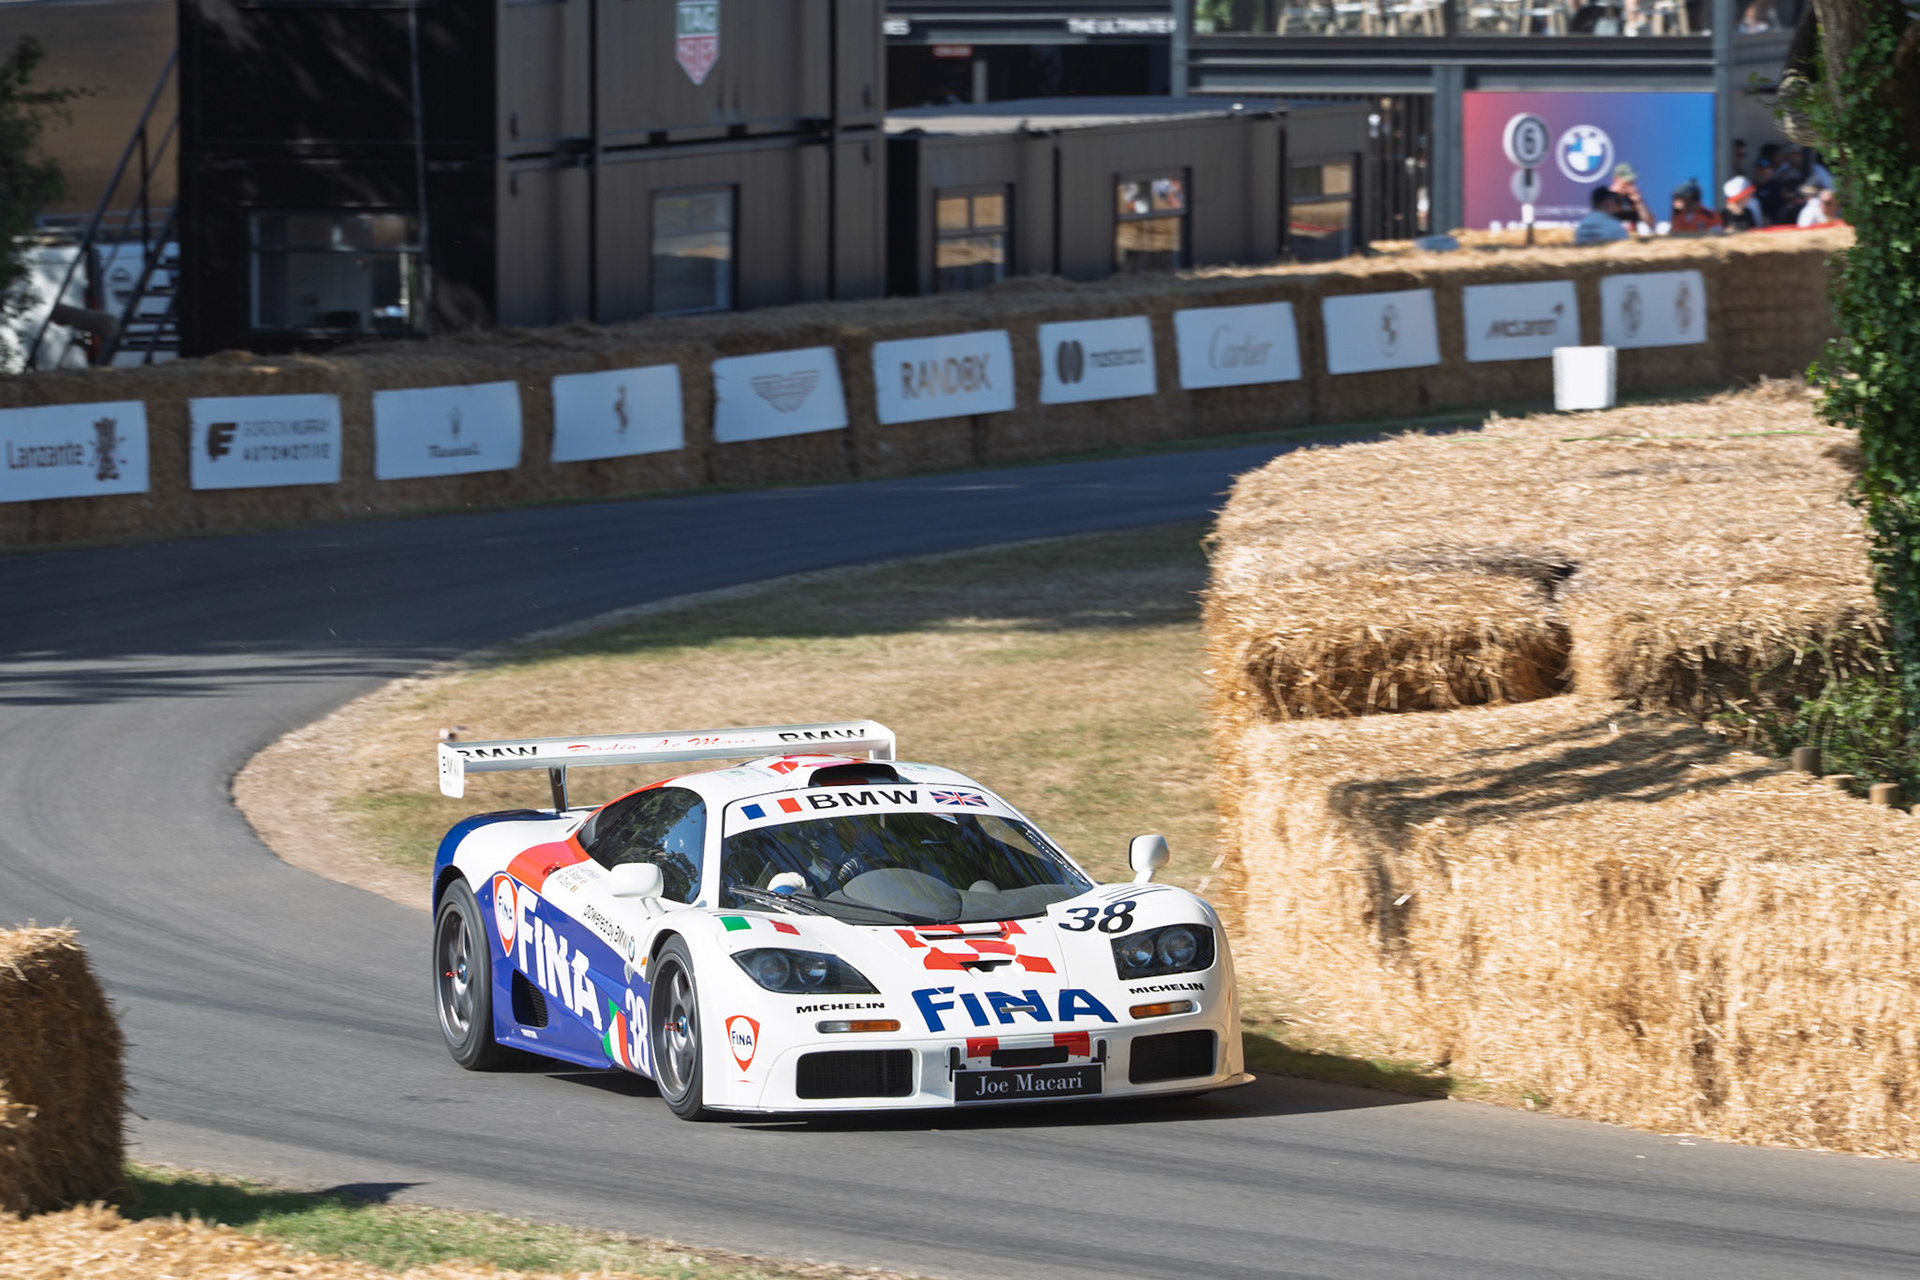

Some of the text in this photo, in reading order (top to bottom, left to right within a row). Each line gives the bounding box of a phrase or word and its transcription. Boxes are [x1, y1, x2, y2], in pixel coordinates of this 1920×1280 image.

[680, 6, 717, 31] TAG
[1523, 126, 1536, 155] 6
[1485, 317, 1557, 339] McLaren
[1208, 324, 1273, 370] Cartier
[900, 353, 993, 400] RANDOX
[5, 440, 85, 470] Lanzante
[243, 443, 330, 461] AUTOMOTIVE
[778, 728, 866, 743] BMW
[806, 790, 918, 810] BMW
[498, 895, 514, 923] FINA
[1058, 900, 1137, 934] 38
[517, 884, 603, 1032] FINA
[1128, 982, 1205, 995] MICHELIN
[796, 1002, 885, 1014] MICHELIN
[911, 986, 1119, 1033] FINA
[625, 987, 653, 1077] 38
[731, 1030, 753, 1047] FINA
[976, 1071, 1083, 1096] Joe Macari
